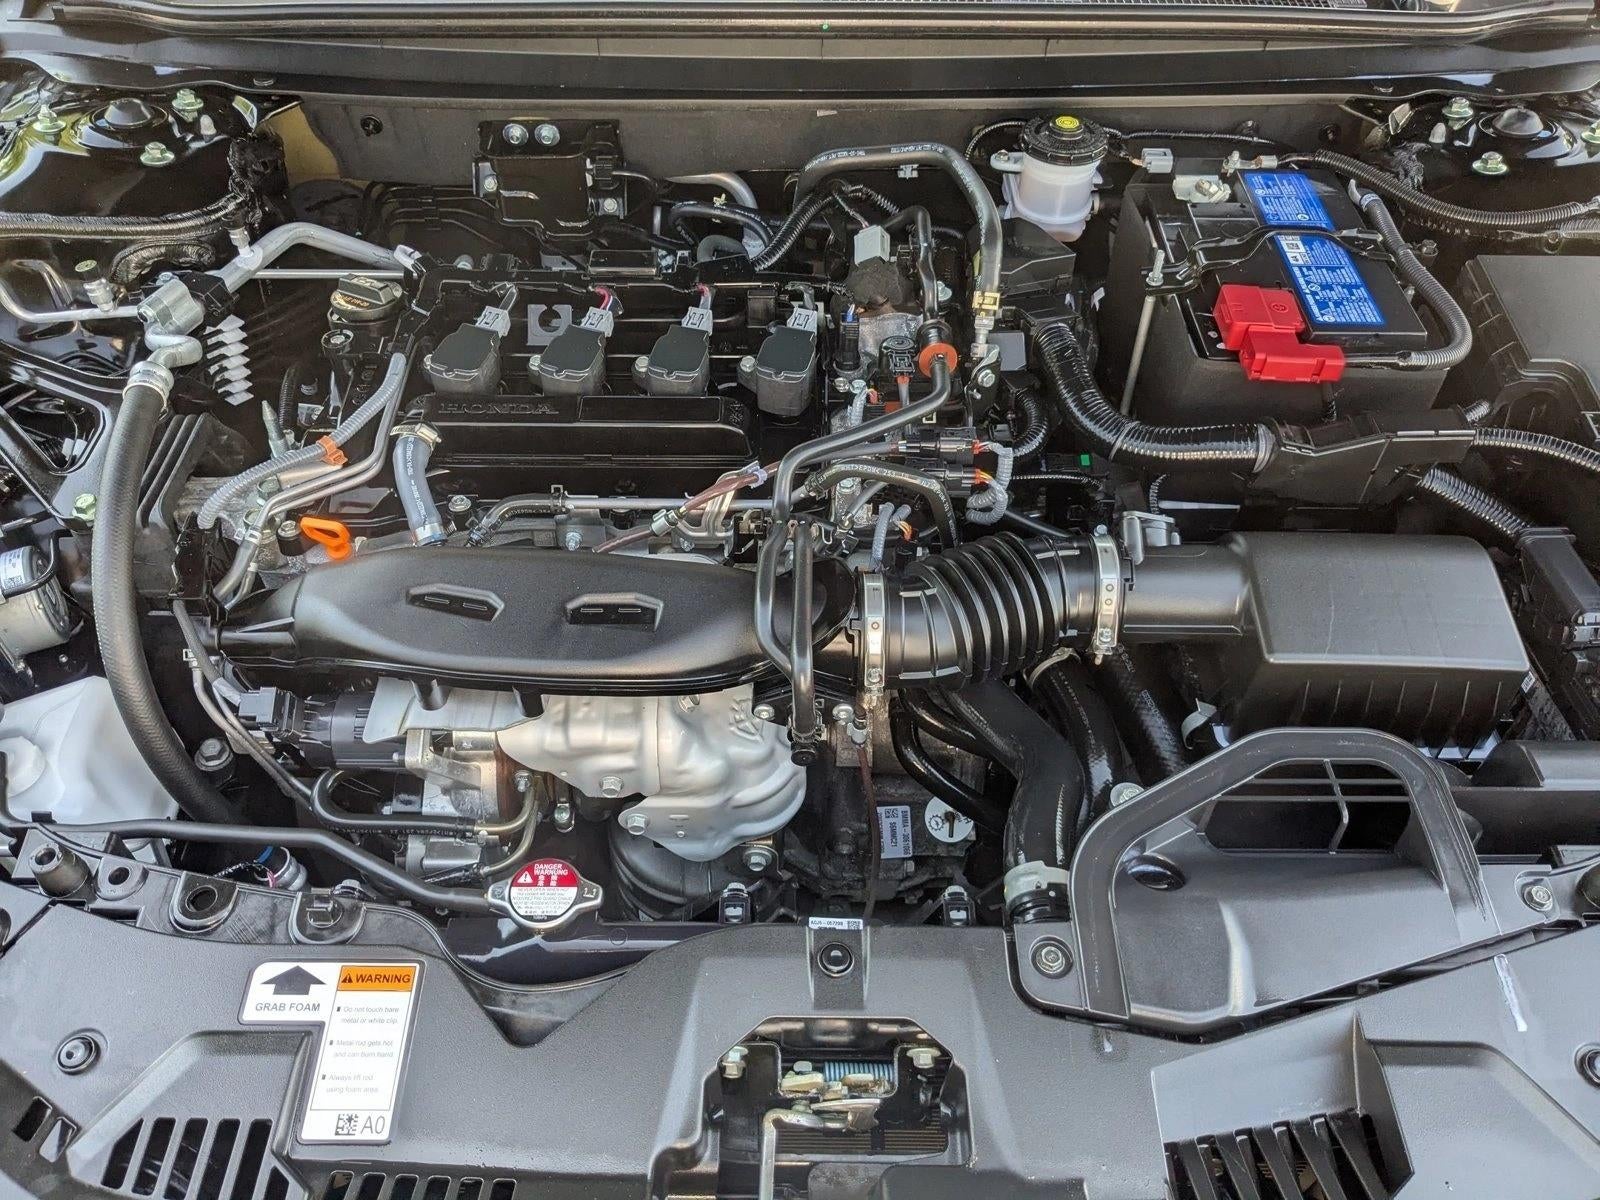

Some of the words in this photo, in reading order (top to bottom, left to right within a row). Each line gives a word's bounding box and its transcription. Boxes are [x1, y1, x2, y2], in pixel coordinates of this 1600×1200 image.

[438, 402, 559, 414] HONDA
[355, 973, 411, 984] WARNING
[255, 1002, 286, 1012] GRAB
[288, 1002, 321, 1012] FOAM
[368, 1016, 385, 1024] white
[360, 1115, 386, 1135] A0
